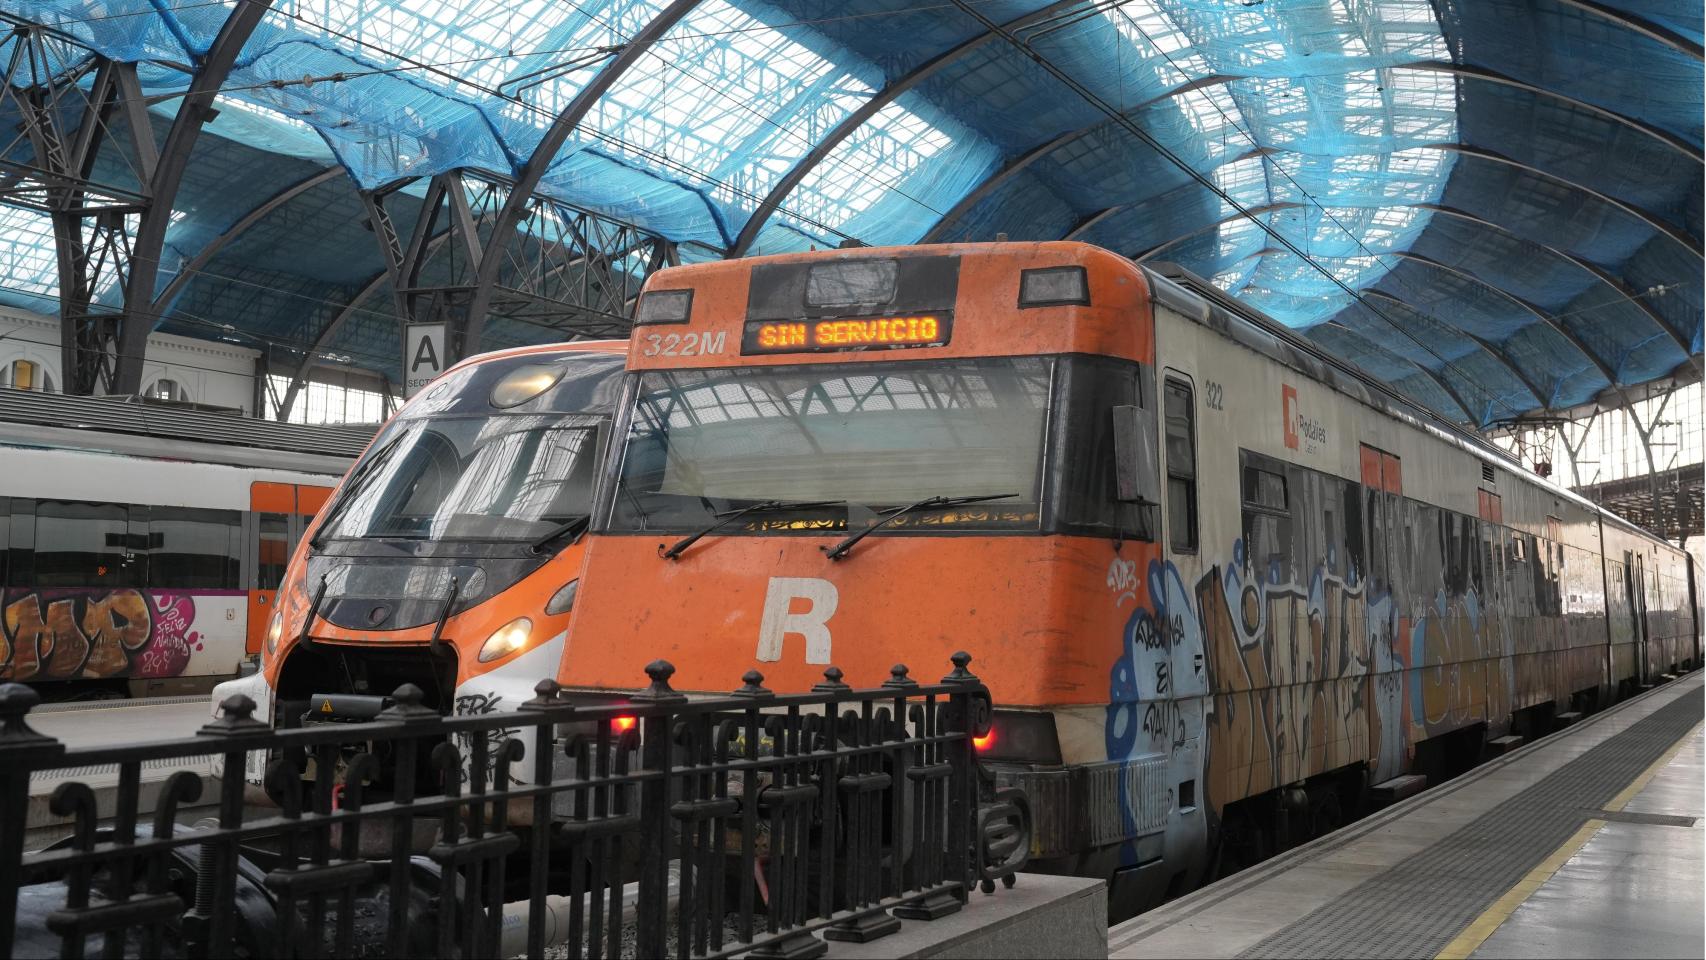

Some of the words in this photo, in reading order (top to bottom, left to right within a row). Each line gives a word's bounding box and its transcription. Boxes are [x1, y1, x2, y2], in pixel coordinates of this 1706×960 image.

[643, 331, 727, 357] 322M
[758, 323, 805, 347] SIN
[815, 316, 938, 345] SERVICIO
[411, 334, 440, 373] A
[407, 378, 435, 389] SECT
[1205, 379, 1224, 411] 322
[755, 576, 839, 665] R
